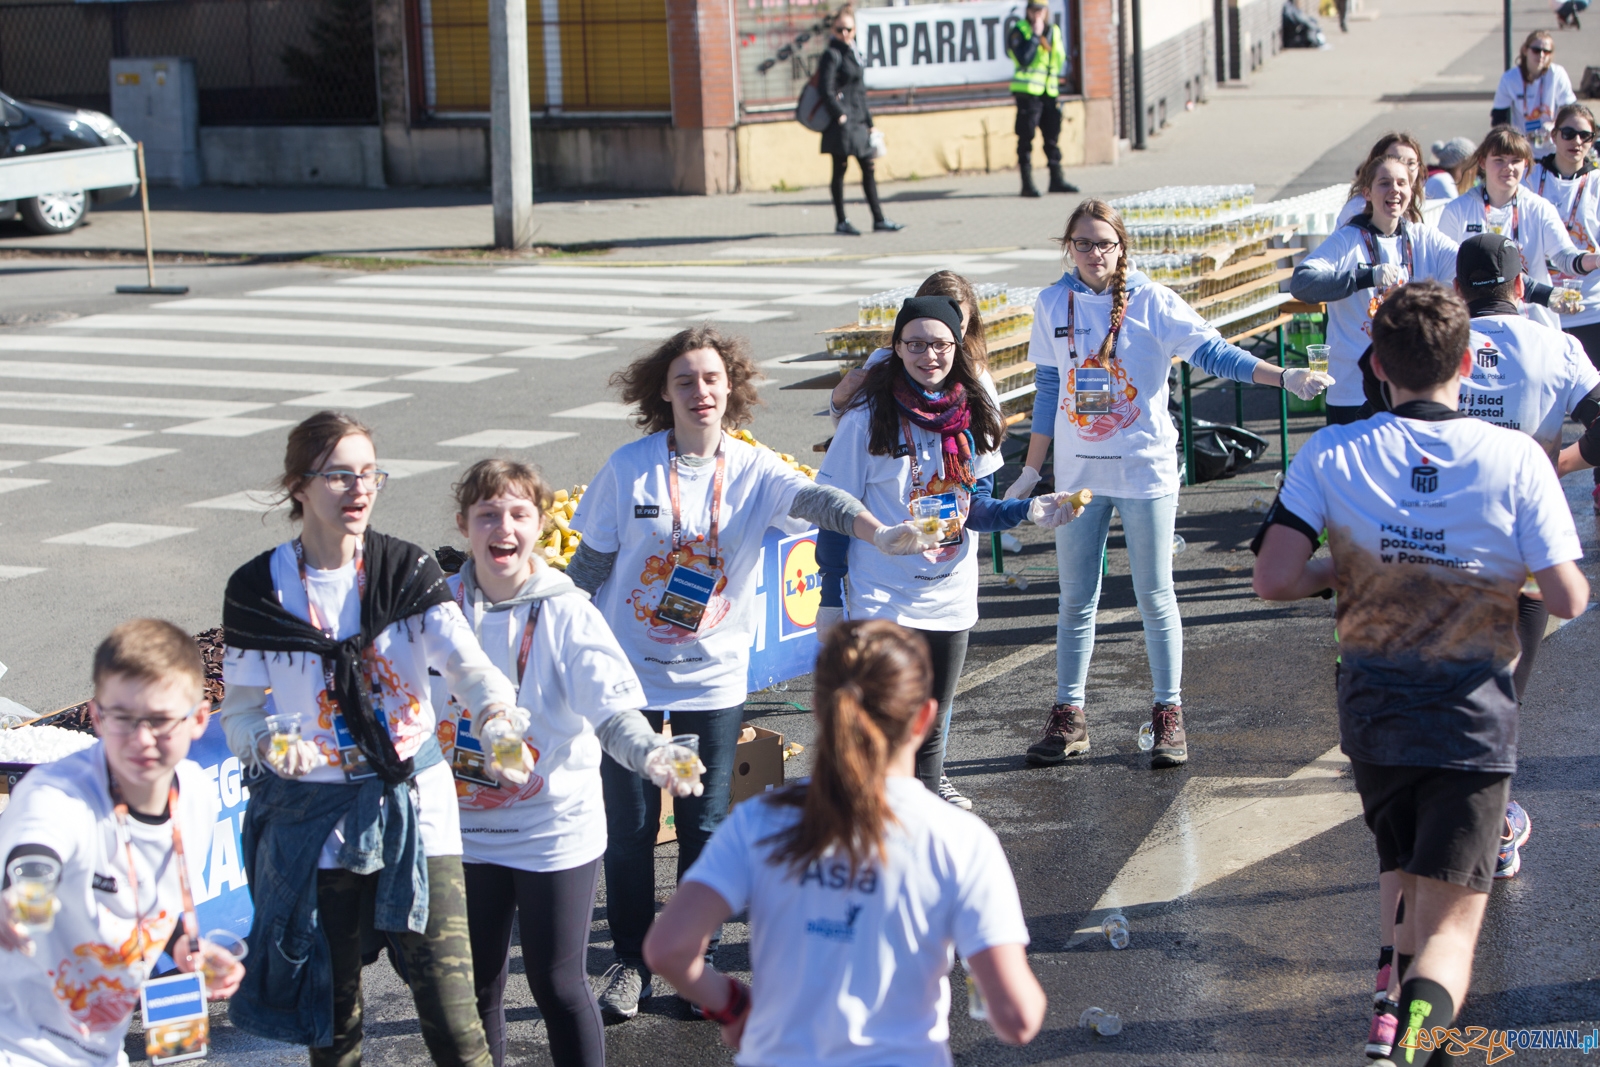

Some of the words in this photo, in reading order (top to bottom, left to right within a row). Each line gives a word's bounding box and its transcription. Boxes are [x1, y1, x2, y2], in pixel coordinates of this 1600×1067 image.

[1477, 394, 1504, 406] ślad
[1411, 528, 1445, 541] ślad
[1381, 537, 1446, 554] pozostał
[1381, 553, 1394, 564] w
[1398, 551, 1470, 570] Poznaniu
